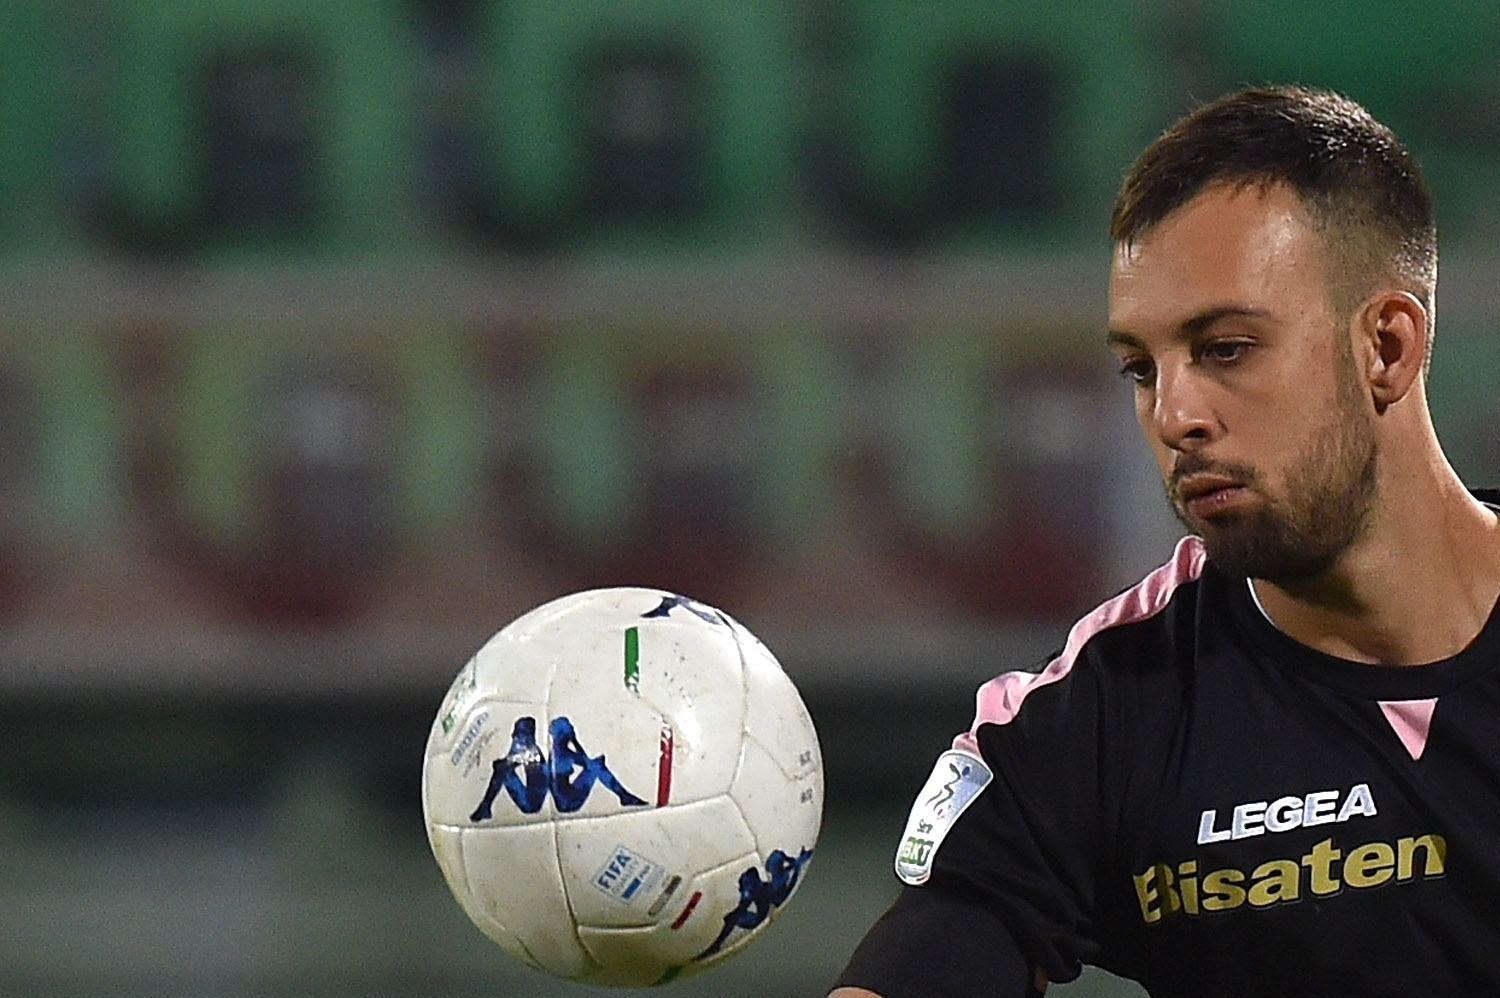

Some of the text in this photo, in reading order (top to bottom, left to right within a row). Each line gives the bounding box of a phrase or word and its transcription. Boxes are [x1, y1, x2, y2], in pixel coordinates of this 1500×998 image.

[1197, 783, 1377, 844] LEGEA
[598, 854, 631, 889] FIFA
[1133, 834, 1447, 923] Bisaten
